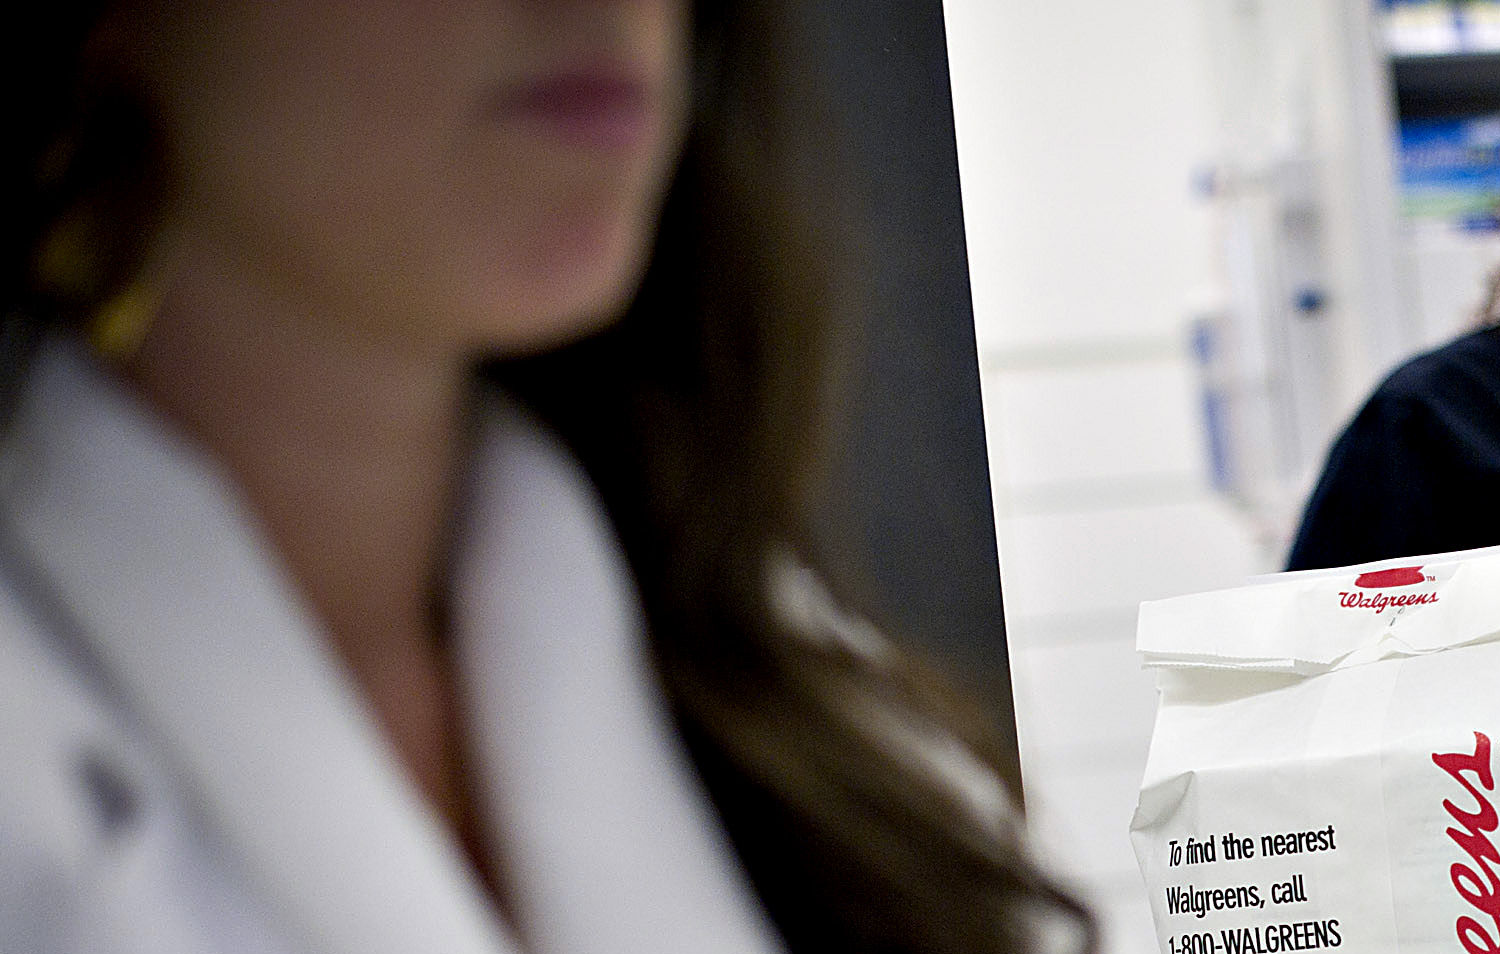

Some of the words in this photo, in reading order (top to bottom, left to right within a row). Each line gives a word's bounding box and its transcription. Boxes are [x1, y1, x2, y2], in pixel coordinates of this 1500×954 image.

[1338, 591, 1440, 614] Walgreens
[1168, 840, 1182, 867] To
[1186, 835, 1217, 865] find
[1221, 832, 1255, 861] the
[1260, 824, 1337, 857] nearest
[1165, 884, 1266, 918] Walgreens,
[1271, 874, 1308, 905] call
